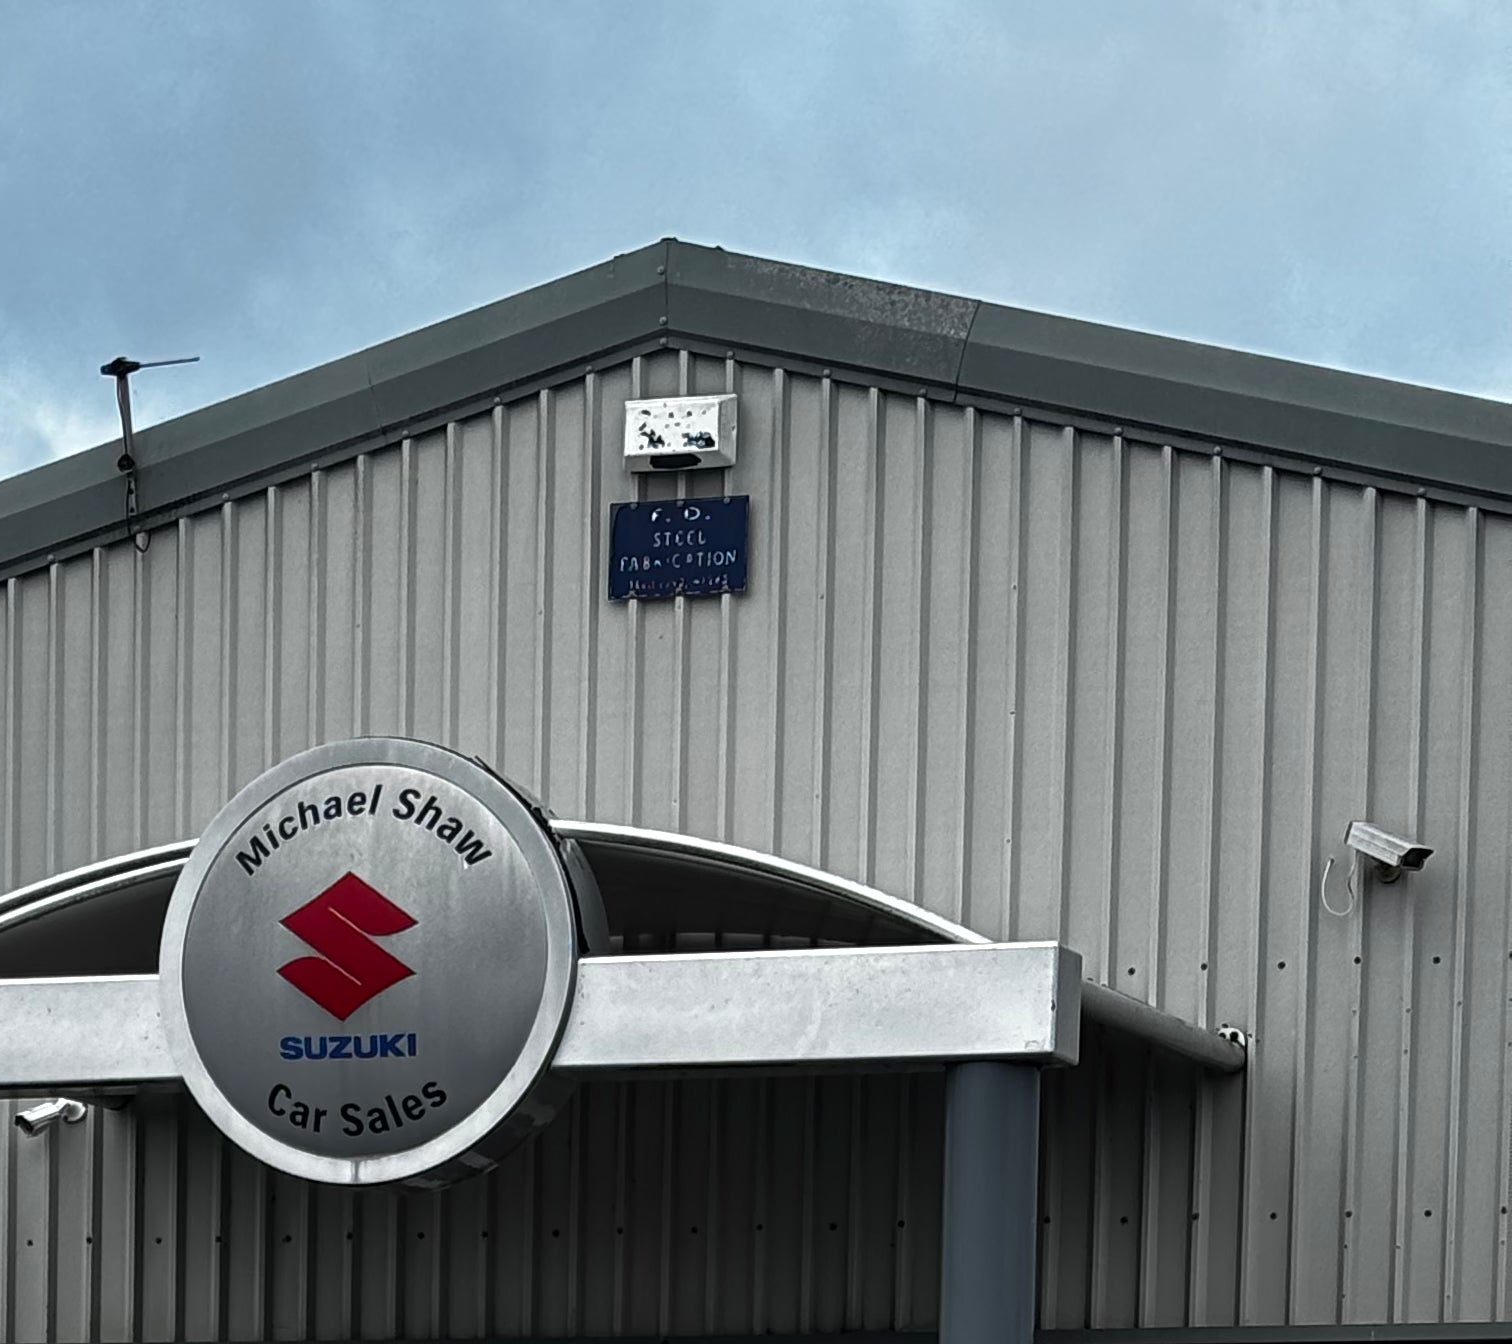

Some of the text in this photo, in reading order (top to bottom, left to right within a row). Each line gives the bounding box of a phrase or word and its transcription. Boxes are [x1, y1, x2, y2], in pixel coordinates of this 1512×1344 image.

[234, 784, 493, 877] Michael Shaw
[279, 1032, 418, 1061] SUZUKI
[267, 1080, 448, 1138] Car Sales
